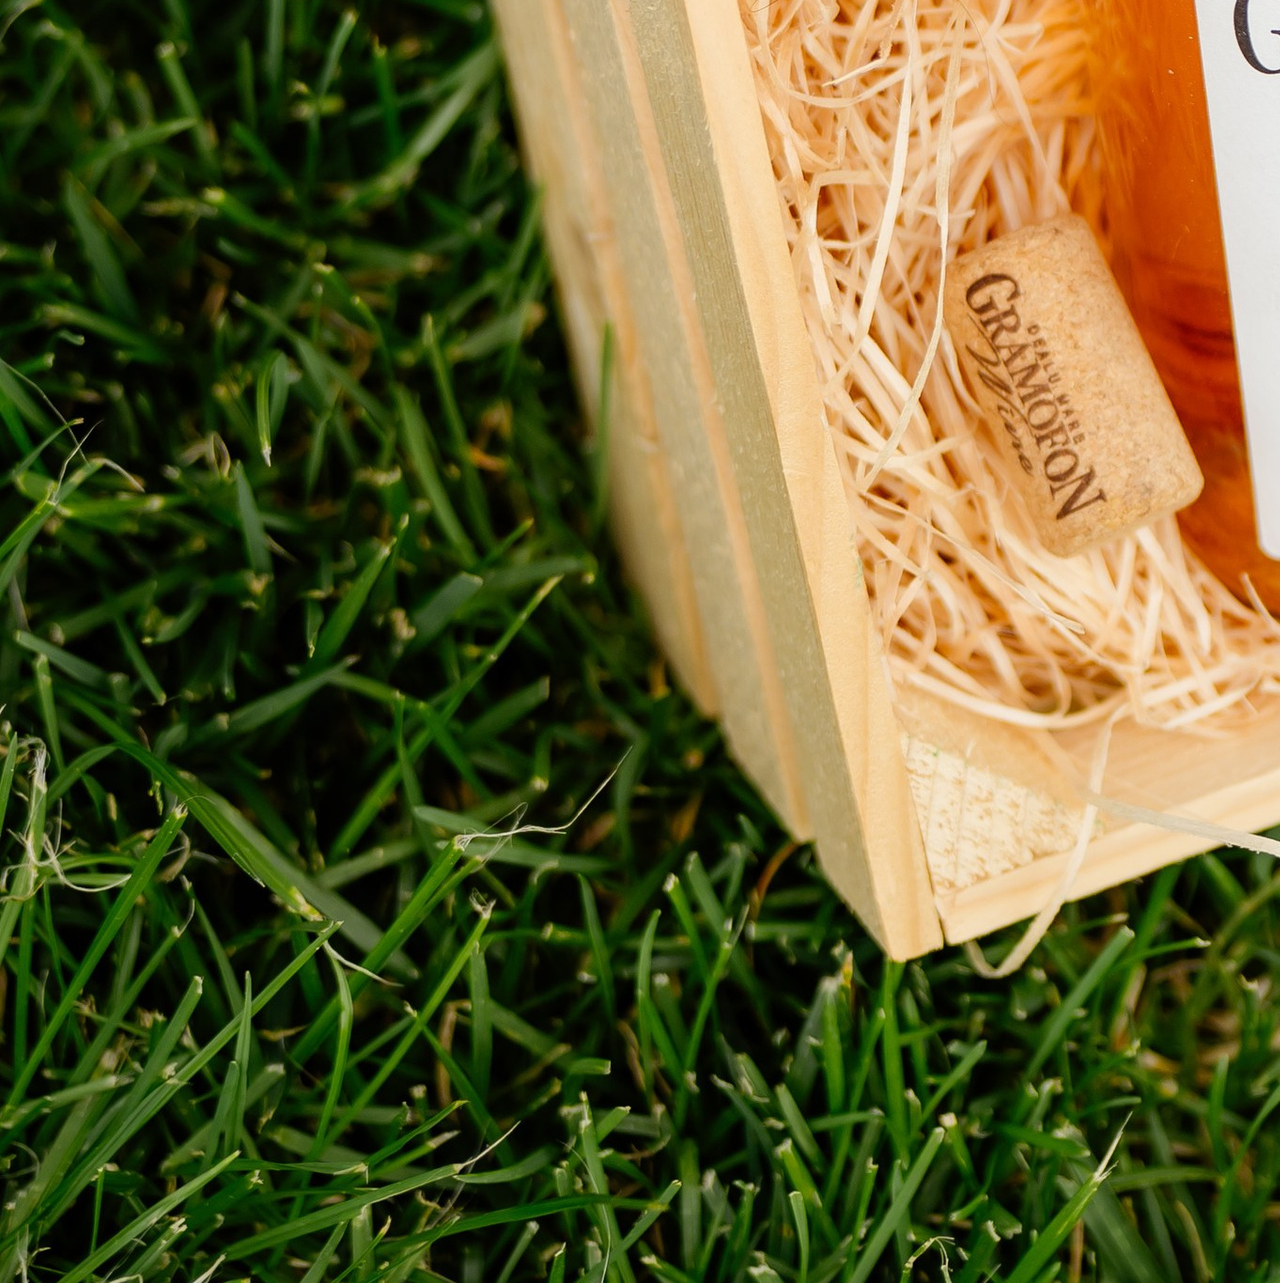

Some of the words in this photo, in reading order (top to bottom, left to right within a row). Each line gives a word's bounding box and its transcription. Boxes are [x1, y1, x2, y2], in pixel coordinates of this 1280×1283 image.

[965, 273, 1107, 521] GRAMOFON
[1026, 323, 1062, 385] DEALU
[1056, 392, 1087, 446] MARE
